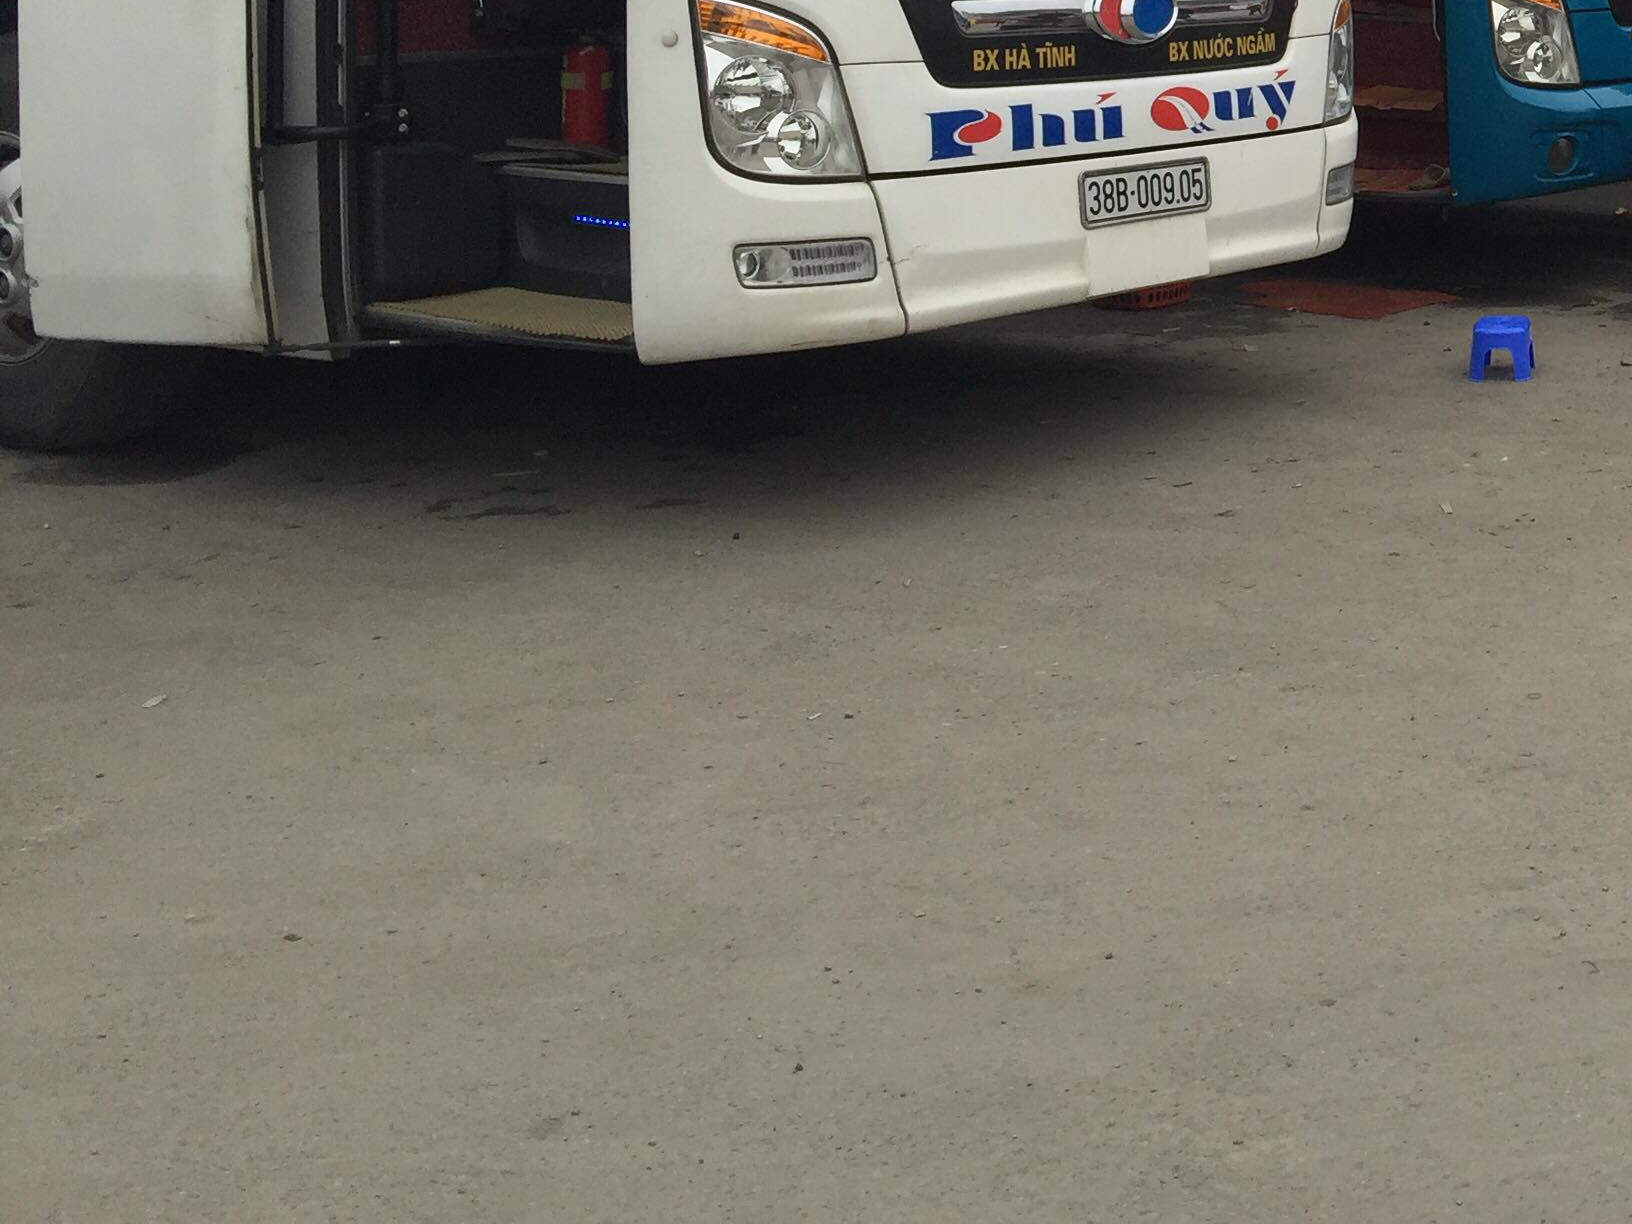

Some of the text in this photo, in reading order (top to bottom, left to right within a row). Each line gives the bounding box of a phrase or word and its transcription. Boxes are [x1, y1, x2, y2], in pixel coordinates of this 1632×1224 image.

[972, 42, 1077, 71] BX HÀ TĨNH
[1169, 41, 1189, 62] BX
[926, 68, 1296, 161] Phú Quý
